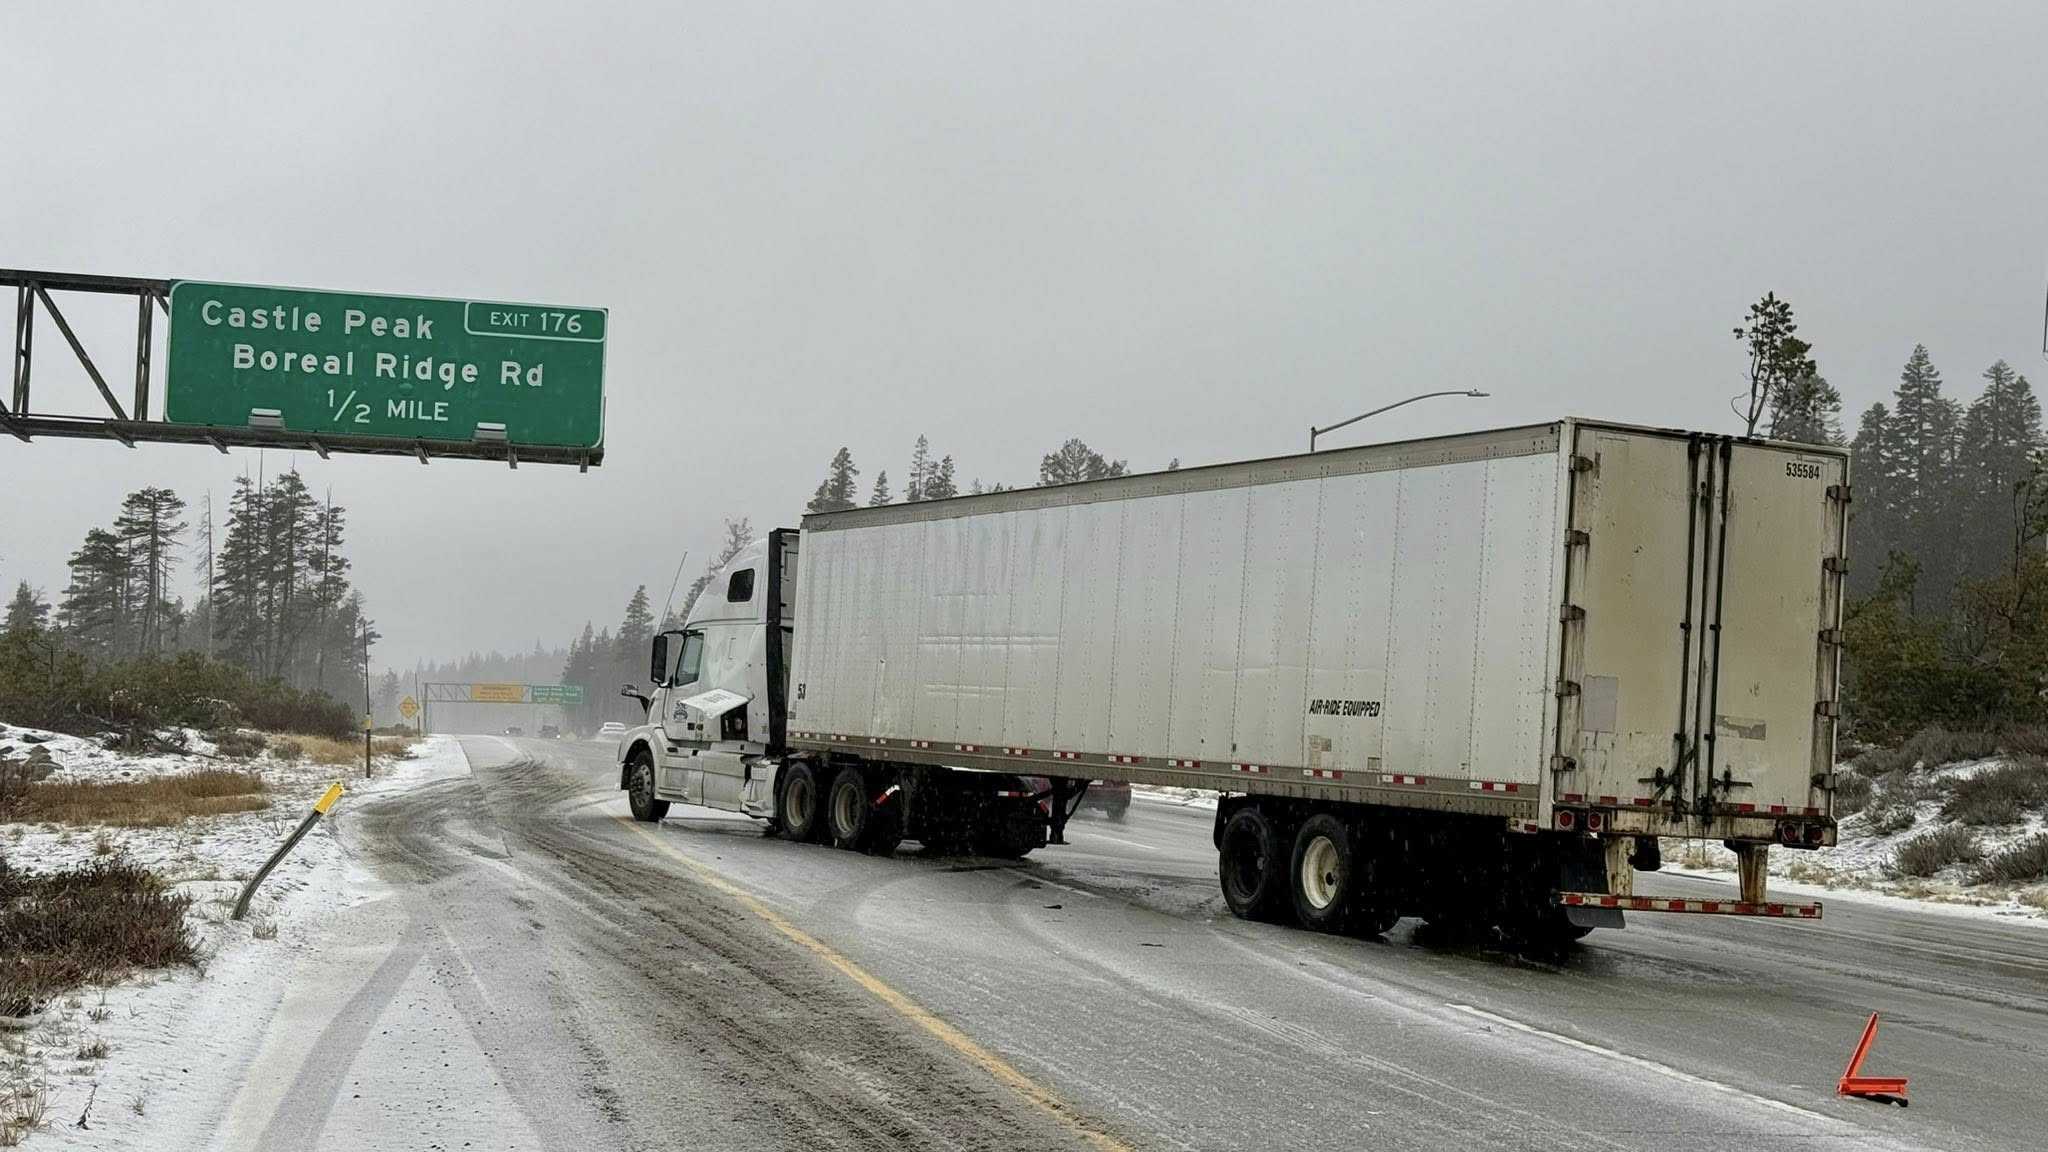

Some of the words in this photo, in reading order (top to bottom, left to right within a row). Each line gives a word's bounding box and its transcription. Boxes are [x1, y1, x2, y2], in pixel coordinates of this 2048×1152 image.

[201, 300, 322, 332] Castle
[344, 309, 434, 340] Peak
[490, 311, 528, 328] EXIT
[540, 312, 582, 334] 176
[233, 344, 354, 376] Boreal
[375, 352, 478, 390] Ridge
[500, 360, 544, 387] Rd
[327, 389, 371, 424] 1/2
[387, 399, 449, 422] MILE
[1786, 462, 1820, 480] 535584
[797, 683, 806, 700] 53
[1308, 699, 1342, 716] AIR-RIDE
[1342, 700, 1381, 717] EQUIPPED
